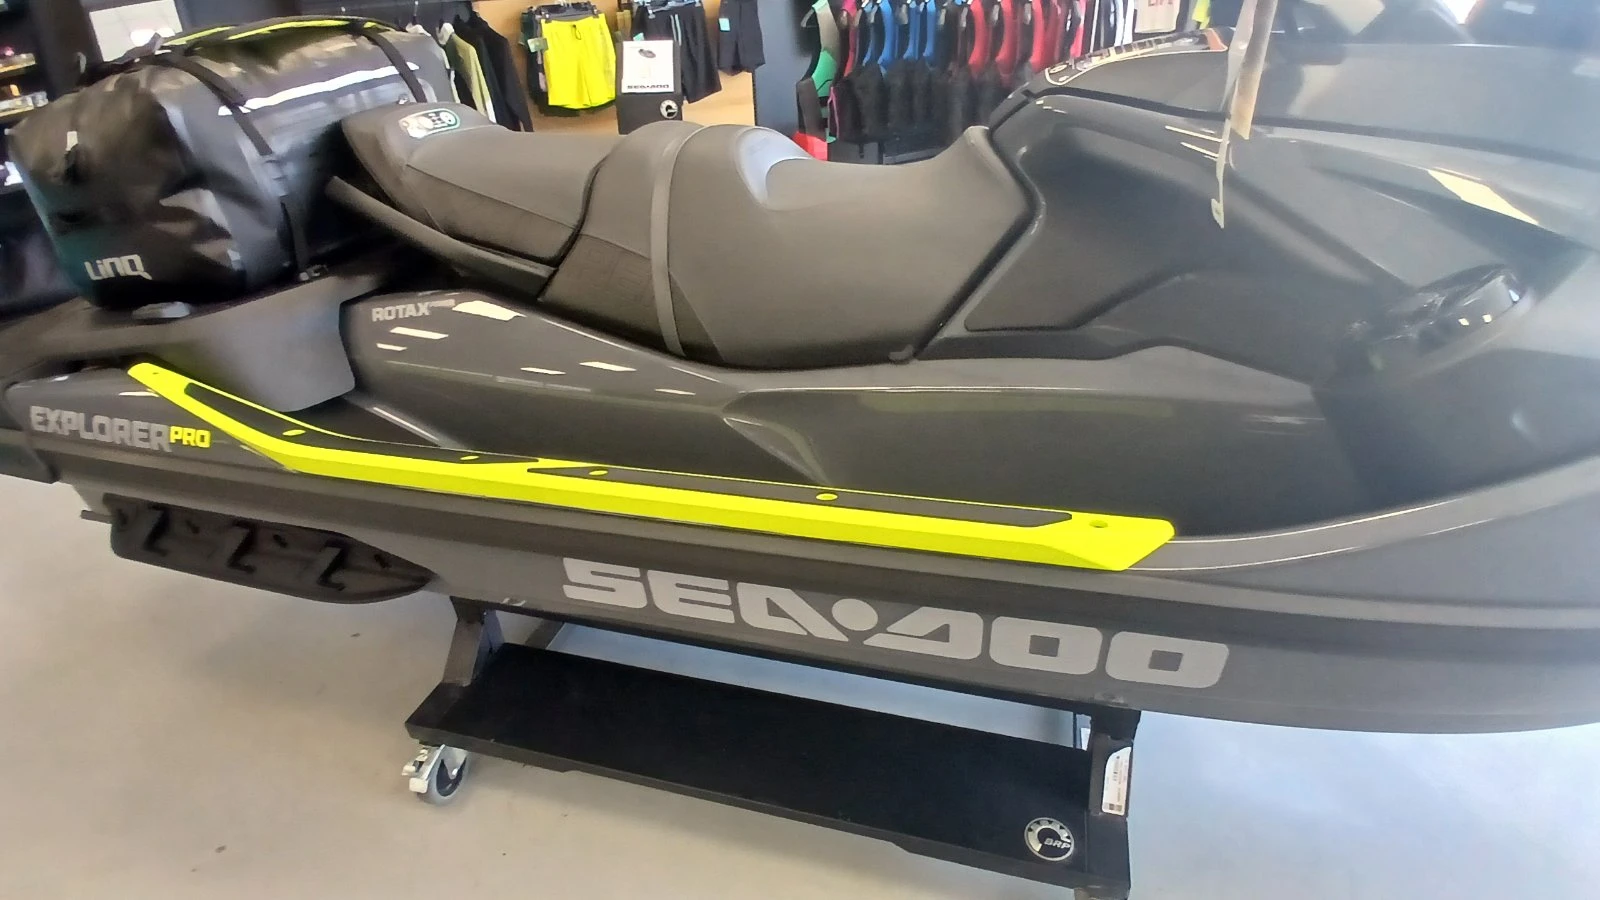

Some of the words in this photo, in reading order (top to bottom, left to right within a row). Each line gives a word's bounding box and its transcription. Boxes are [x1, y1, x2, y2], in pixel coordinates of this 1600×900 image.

[372, 302, 430, 322] ROTAX
[30, 405, 172, 452] EXPLORER
[170, 425, 211, 448] PRO
